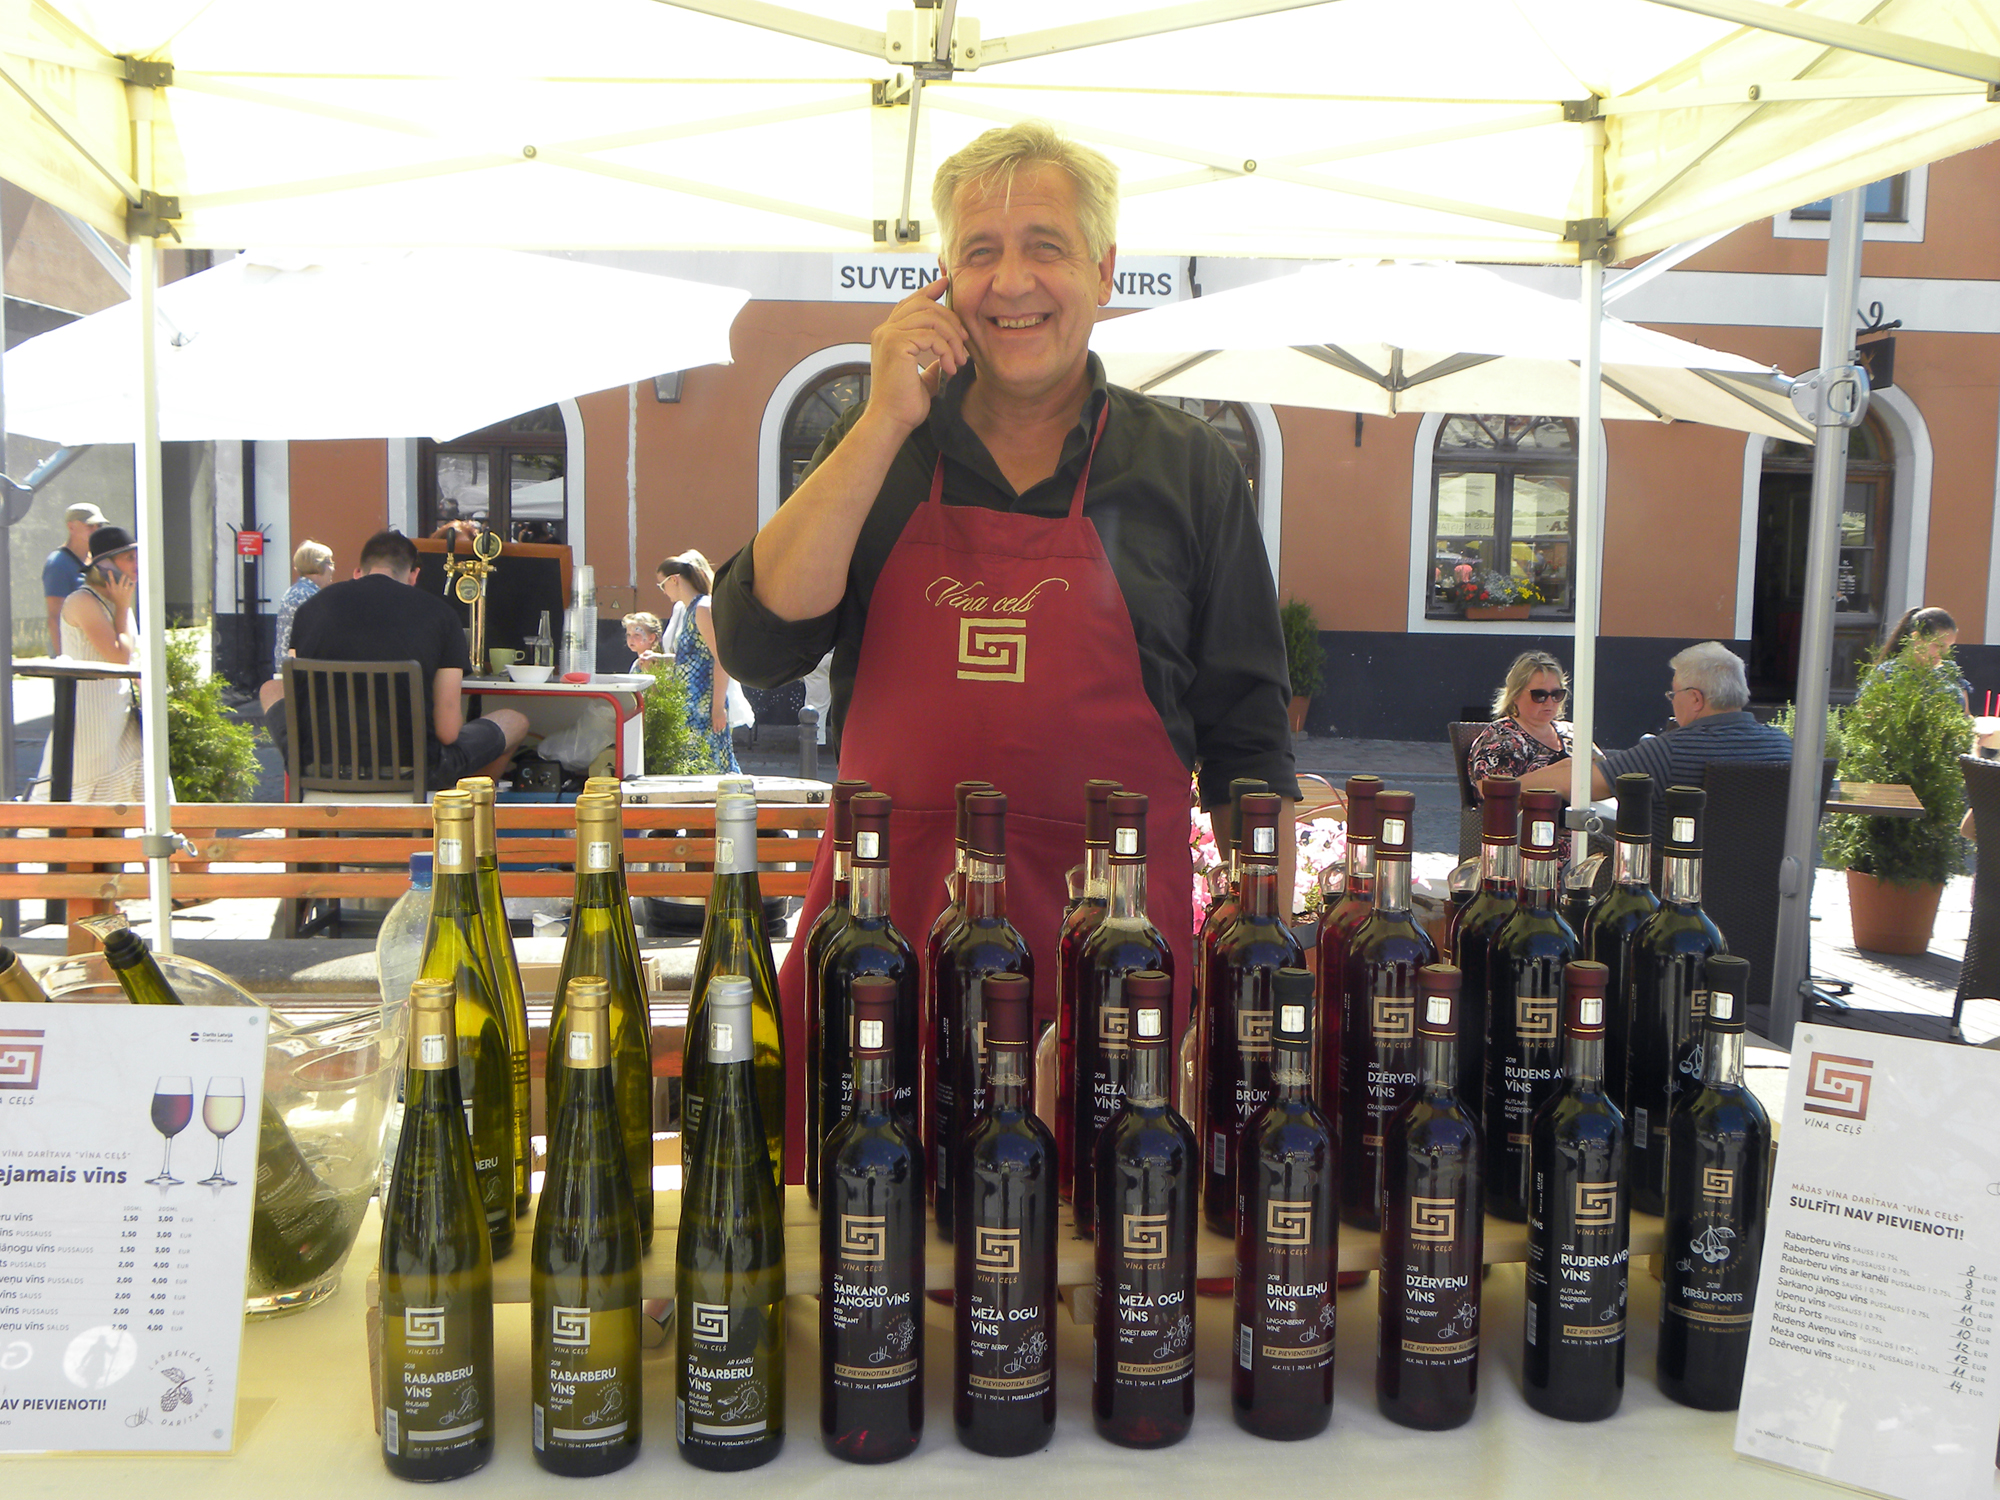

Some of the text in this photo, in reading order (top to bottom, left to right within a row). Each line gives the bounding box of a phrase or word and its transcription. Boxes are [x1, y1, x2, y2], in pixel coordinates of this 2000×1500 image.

[1367, 1070, 1417, 1090] DZĒRVEŅ
[1504, 1065, 1551, 1081] RUDENS
[1093, 1081, 1127, 1096] MEŽA
[1367, 1085, 1396, 1099] VĪNS
[1504, 1079, 1533, 1094] VĪNS
[8, 1095, 35, 1107] CEĻŠ
[1094, 1096, 1122, 1110] VĪNS
[1804, 1117, 1863, 1137] VĪNA CEĻŠ
[1, 1149, 24, 1158] VĪNA
[27, 1149, 72, 1159] DARĪTAVA
[83, 1167, 128, 1184] vīns
[1791, 1182, 1823, 1196] MĀJAS
[1825, 1189, 1848, 1201] VĪNA
[1852, 1194, 1899, 1211] DARĪTAVA
[13, 1211, 34, 1222] vīns
[123, 1215, 139, 1223] 1,50
[157, 1215, 174, 1223] 3,00
[1789, 1195, 1965, 1240] SULFĪTI NAV PIEVIENOTI!
[121, 1230, 172, 1239] 1,50 3,00
[1576, 1228, 1595, 1236] VĪNA
[1561, 1243, 1575, 1251] 2018
[1785, 1230, 1830, 1245] Rabarberu
[1831, 1239, 1852, 1251] vīns
[35, 1243, 55, 1253] vīns
[119, 1246, 136, 1254] 1,50
[154, 1246, 171, 1255] 3,00
[1783, 1242, 1829, 1257] Raberberu
[1830, 1251, 1851, 1263] vīns
[117, 1261, 170, 1269] 2,00 4,00
[1560, 1249, 1629, 1268] RUDENS AVE
[1781, 1254, 1827, 1268] Rabarberu
[1828, 1262, 1848, 1275] vīns
[1849, 1268, 1859, 1277] ar
[842, 1262, 861, 1272] VĪNA
[1406, 1264, 1419, 1273] 2018
[25, 1274, 168, 1285] vīns 2,00 4,00
[1267, 1273, 1281, 1282] 2018
[1406, 1274, 1469, 1292] DZĒRVEŅU
[1560, 1268, 1591, 1283] VĪNS
[1779, 1266, 1819, 1281] Brūkleņu
[1820, 1273, 1840, 1286] vīns
[833, 1281, 889, 1297] SARKANO
[1119, 1282, 1132, 1291] 2018
[1266, 1281, 1328, 1300] BRŪKLEŅU
[1559, 1288, 1587, 1296] AUTUMN
[1682, 1285, 1743, 1302] ĶIRŠU PORTS
[1778, 1278, 1813, 1290] Sarkano
[1814, 1285, 1847, 1301] jāņogu
[1848, 1292, 1869, 1305] vīns
[114, 1292, 167, 1301] 2,00 4,00
[833, 1292, 911, 1310] JĀŅOGU VĪNS
[970, 1294, 983, 1304] 2018
[1119, 1290, 1186, 1308] MEŽA OGU
[1406, 1289, 1436, 1304] VĪNS
[1559, 1294, 1592, 1304] RASPBERRY
[1776, 1289, 1805, 1304] Upeņu
[1807, 1295, 1826, 1307] vīns
[0, 1305, 165, 1316] vīns 2,00 4,00
[1266, 1298, 1297, 1312] VĪNS
[1774, 1301, 1796, 1313] Ķiršu
[1798, 1306, 1822, 1318] Ports
[970, 1305, 1039, 1322] MEŽA OGU
[1119, 1308, 1149, 1323] VĪNS
[1405, 1308, 1439, 1318] CRANBERRY
[24, 1321, 164, 1332] vīns 2,00 4,00
[970, 1320, 1000, 1336] VĪNS
[1119, 1328, 1159, 1337] FOREST BERRY
[1772, 1313, 1805, 1327] Rudens
[1807, 1321, 1836, 1336] Aveņu
[1837, 1328, 1857, 1340] vīns
[1769, 1324, 1795, 1338] Meža
[1795, 1332, 1815, 1344] ogu
[1815, 1335, 1835, 1348] vīns
[970, 1340, 1010, 1352] FOREST BERRY
[1768, 1338, 1811, 1354] Dzērveņu
[1812, 1347, 1833, 1360] vīns
[404, 1365, 474, 1384] RABARBERU
[550, 1367, 617, 1383] RABARBERU
[688, 1363, 754, 1381] RABARBERU
[404, 1385, 433, 1399] VĪNS
[550, 1382, 576, 1396] VĪNS
[688, 1377, 712, 1393] VĪNS
[22, 1398, 107, 1411] PIEVIENOTI!
